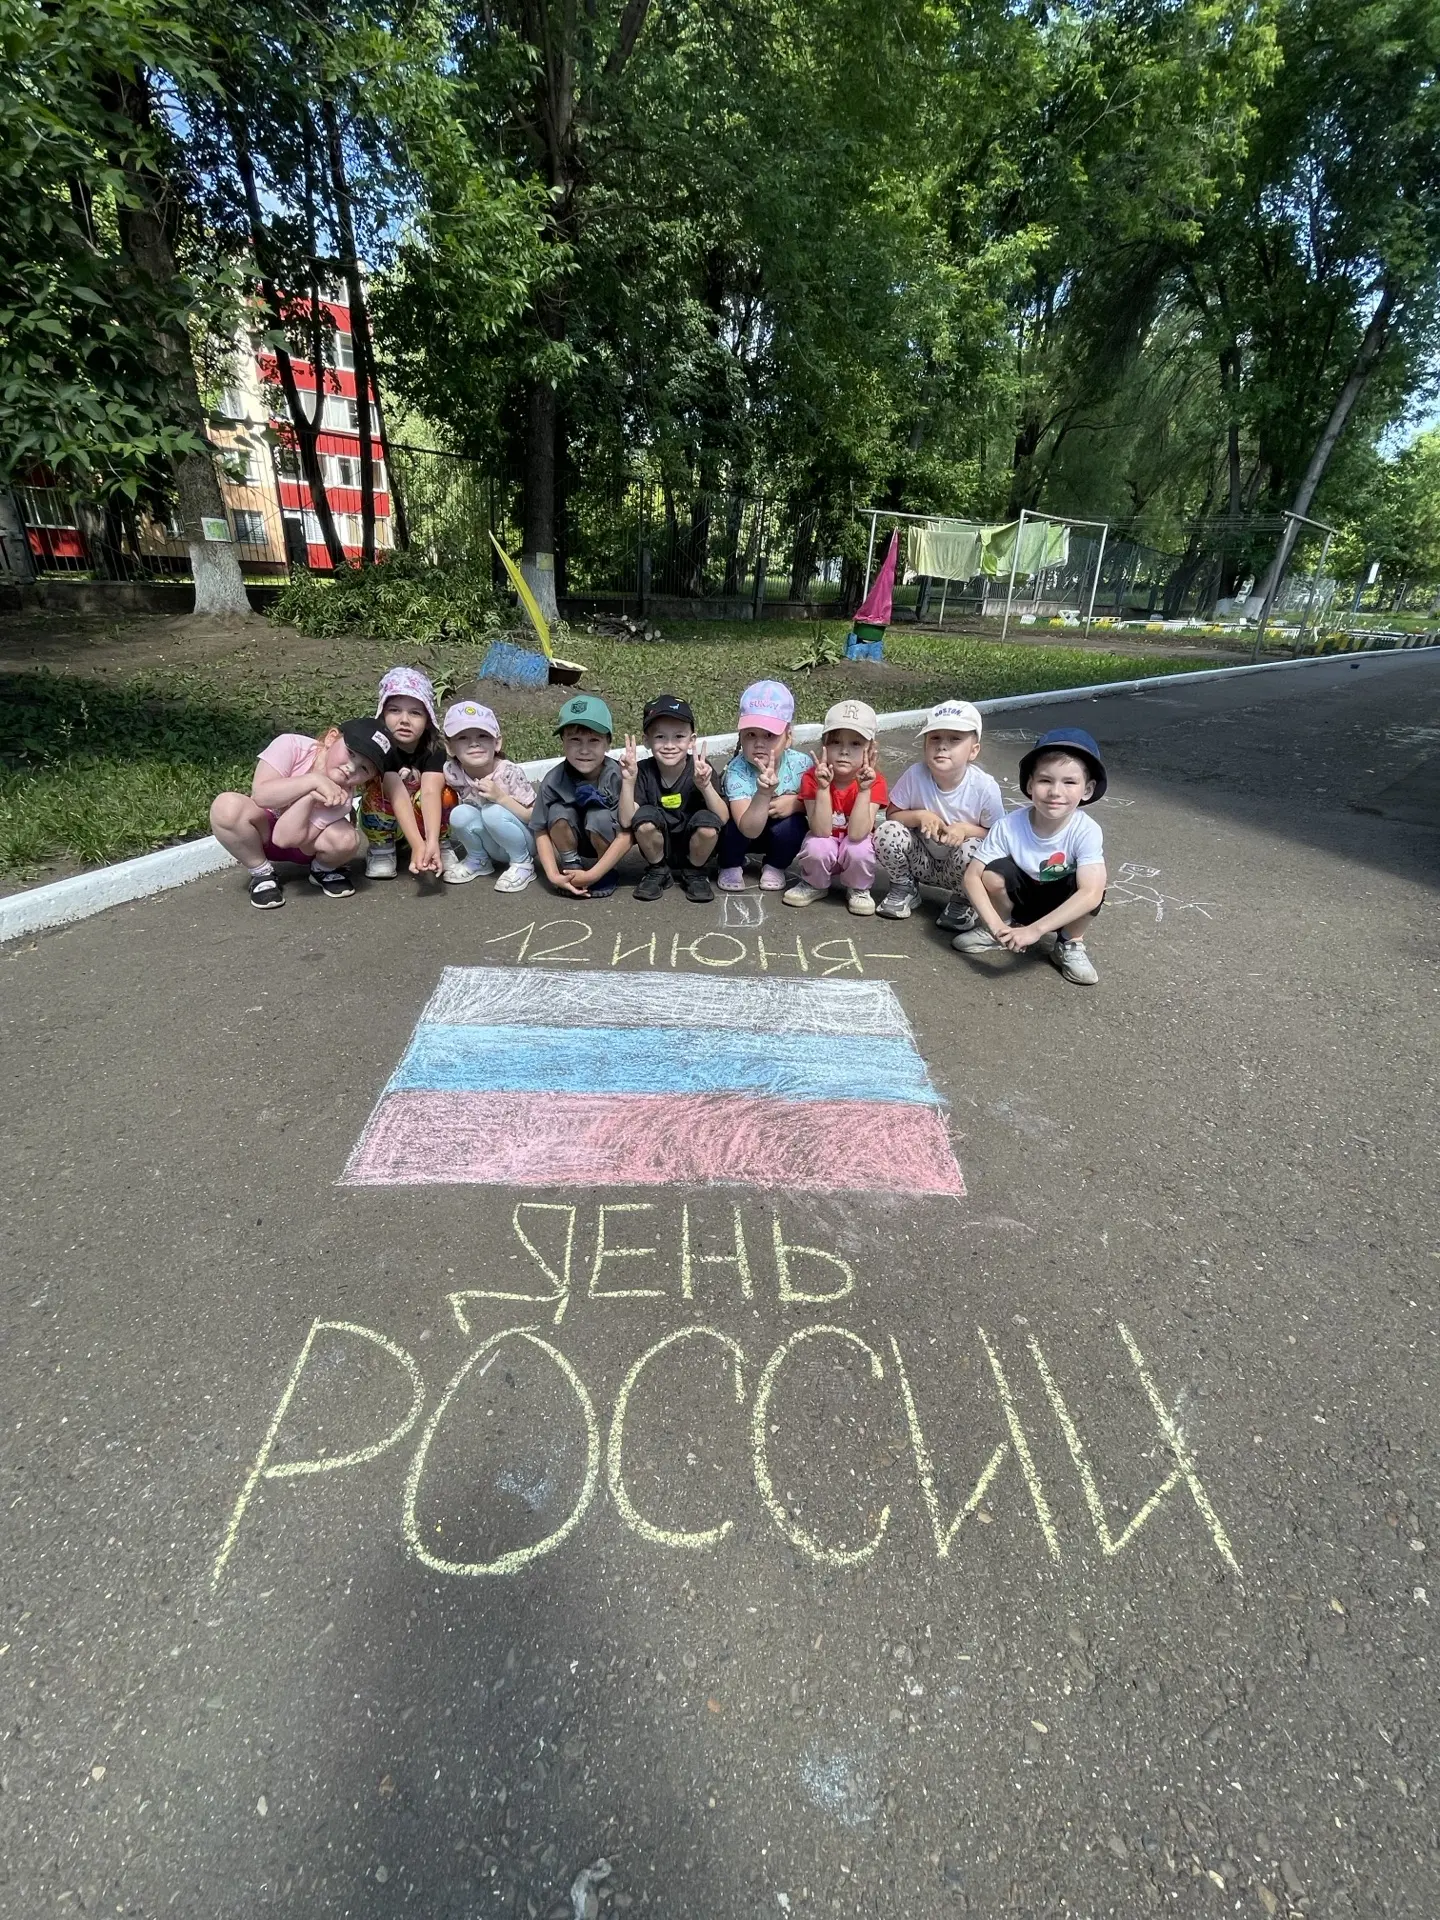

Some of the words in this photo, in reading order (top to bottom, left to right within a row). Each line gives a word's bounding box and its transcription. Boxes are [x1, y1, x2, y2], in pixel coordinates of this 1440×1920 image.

[485, 919, 592, 964] 12
[444, 1202, 856, 1335] ДЕНЬ
[211, 1316, 1240, 1592] РОССИИ
